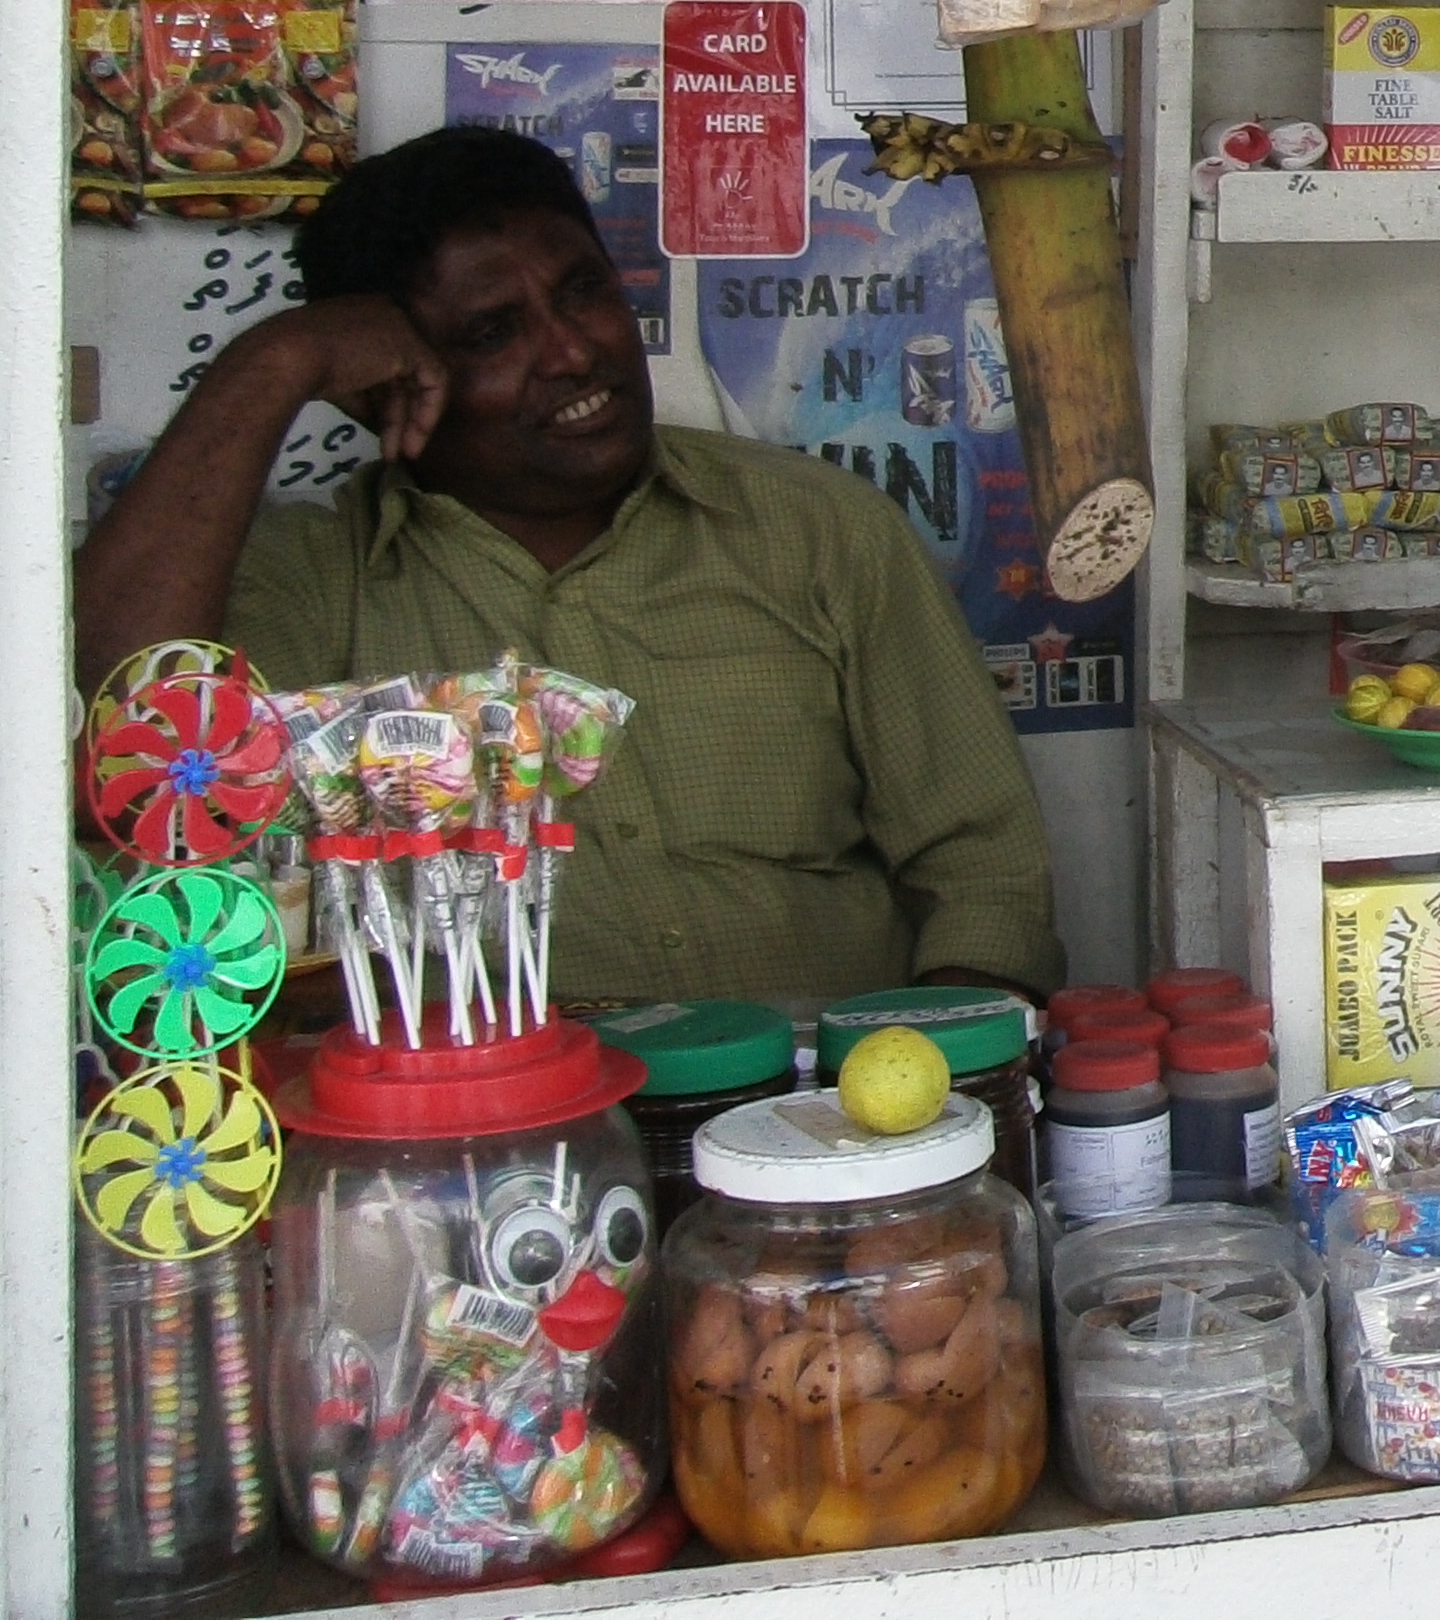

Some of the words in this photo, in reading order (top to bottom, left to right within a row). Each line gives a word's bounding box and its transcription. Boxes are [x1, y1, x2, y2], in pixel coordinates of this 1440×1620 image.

[704, 33, 767, 53] CARD
[673, 74, 797, 94] AVAILABLE
[1374, 79, 1413, 92] FINE
[1368, 93, 1420, 106] TABLE
[1374, 106, 1413, 119] SALT
[705, 114, 765, 134] HERE
[810, 151, 921, 237] ARK
[717, 273, 926, 319] SCRATCH
[1336, 910, 1358, 973] PACK
[1376, 906, 1418, 1065] SUNNY
[1336, 979, 1360, 1062] JUMBO
